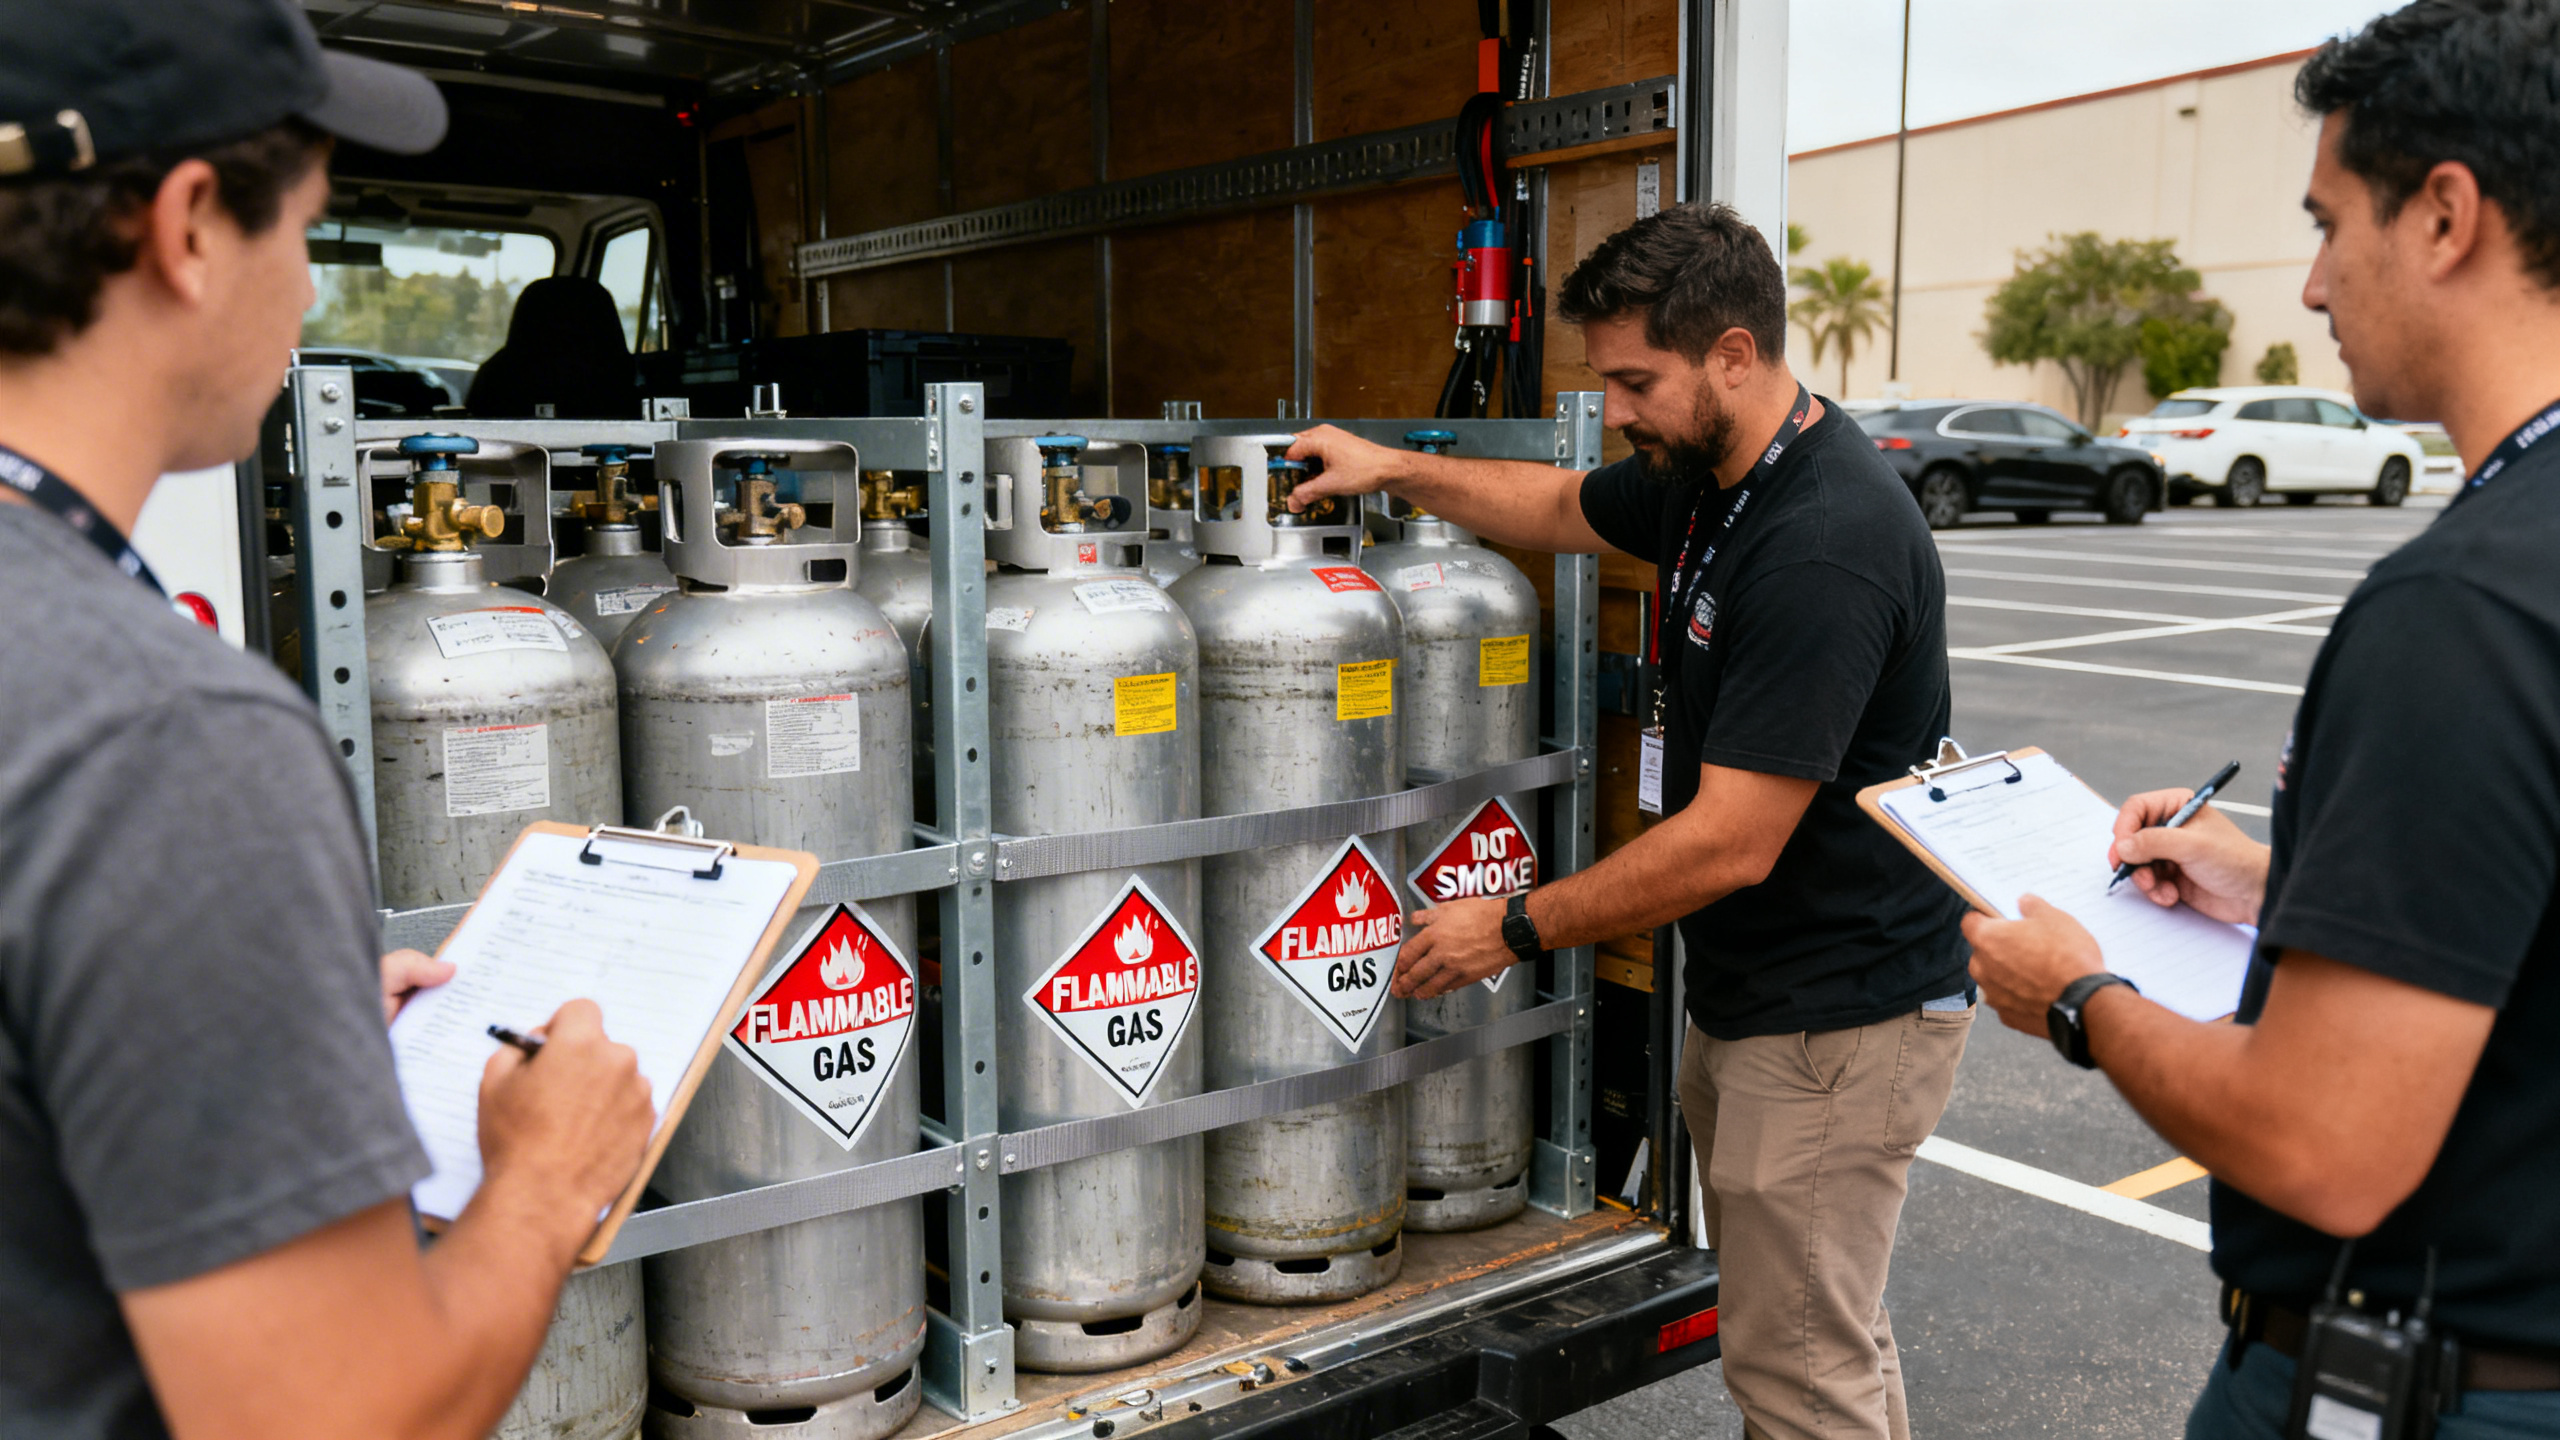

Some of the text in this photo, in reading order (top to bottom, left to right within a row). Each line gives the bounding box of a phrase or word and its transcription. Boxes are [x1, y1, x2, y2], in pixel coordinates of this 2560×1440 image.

[1434, 856, 1533, 899] SMOKE
[1328, 957, 1377, 992] GAS
[748, 978, 914, 1043] FLAMMABLE
[1107, 1009, 1163, 1047] GAS
[813, 1037, 876, 1082] GAS
